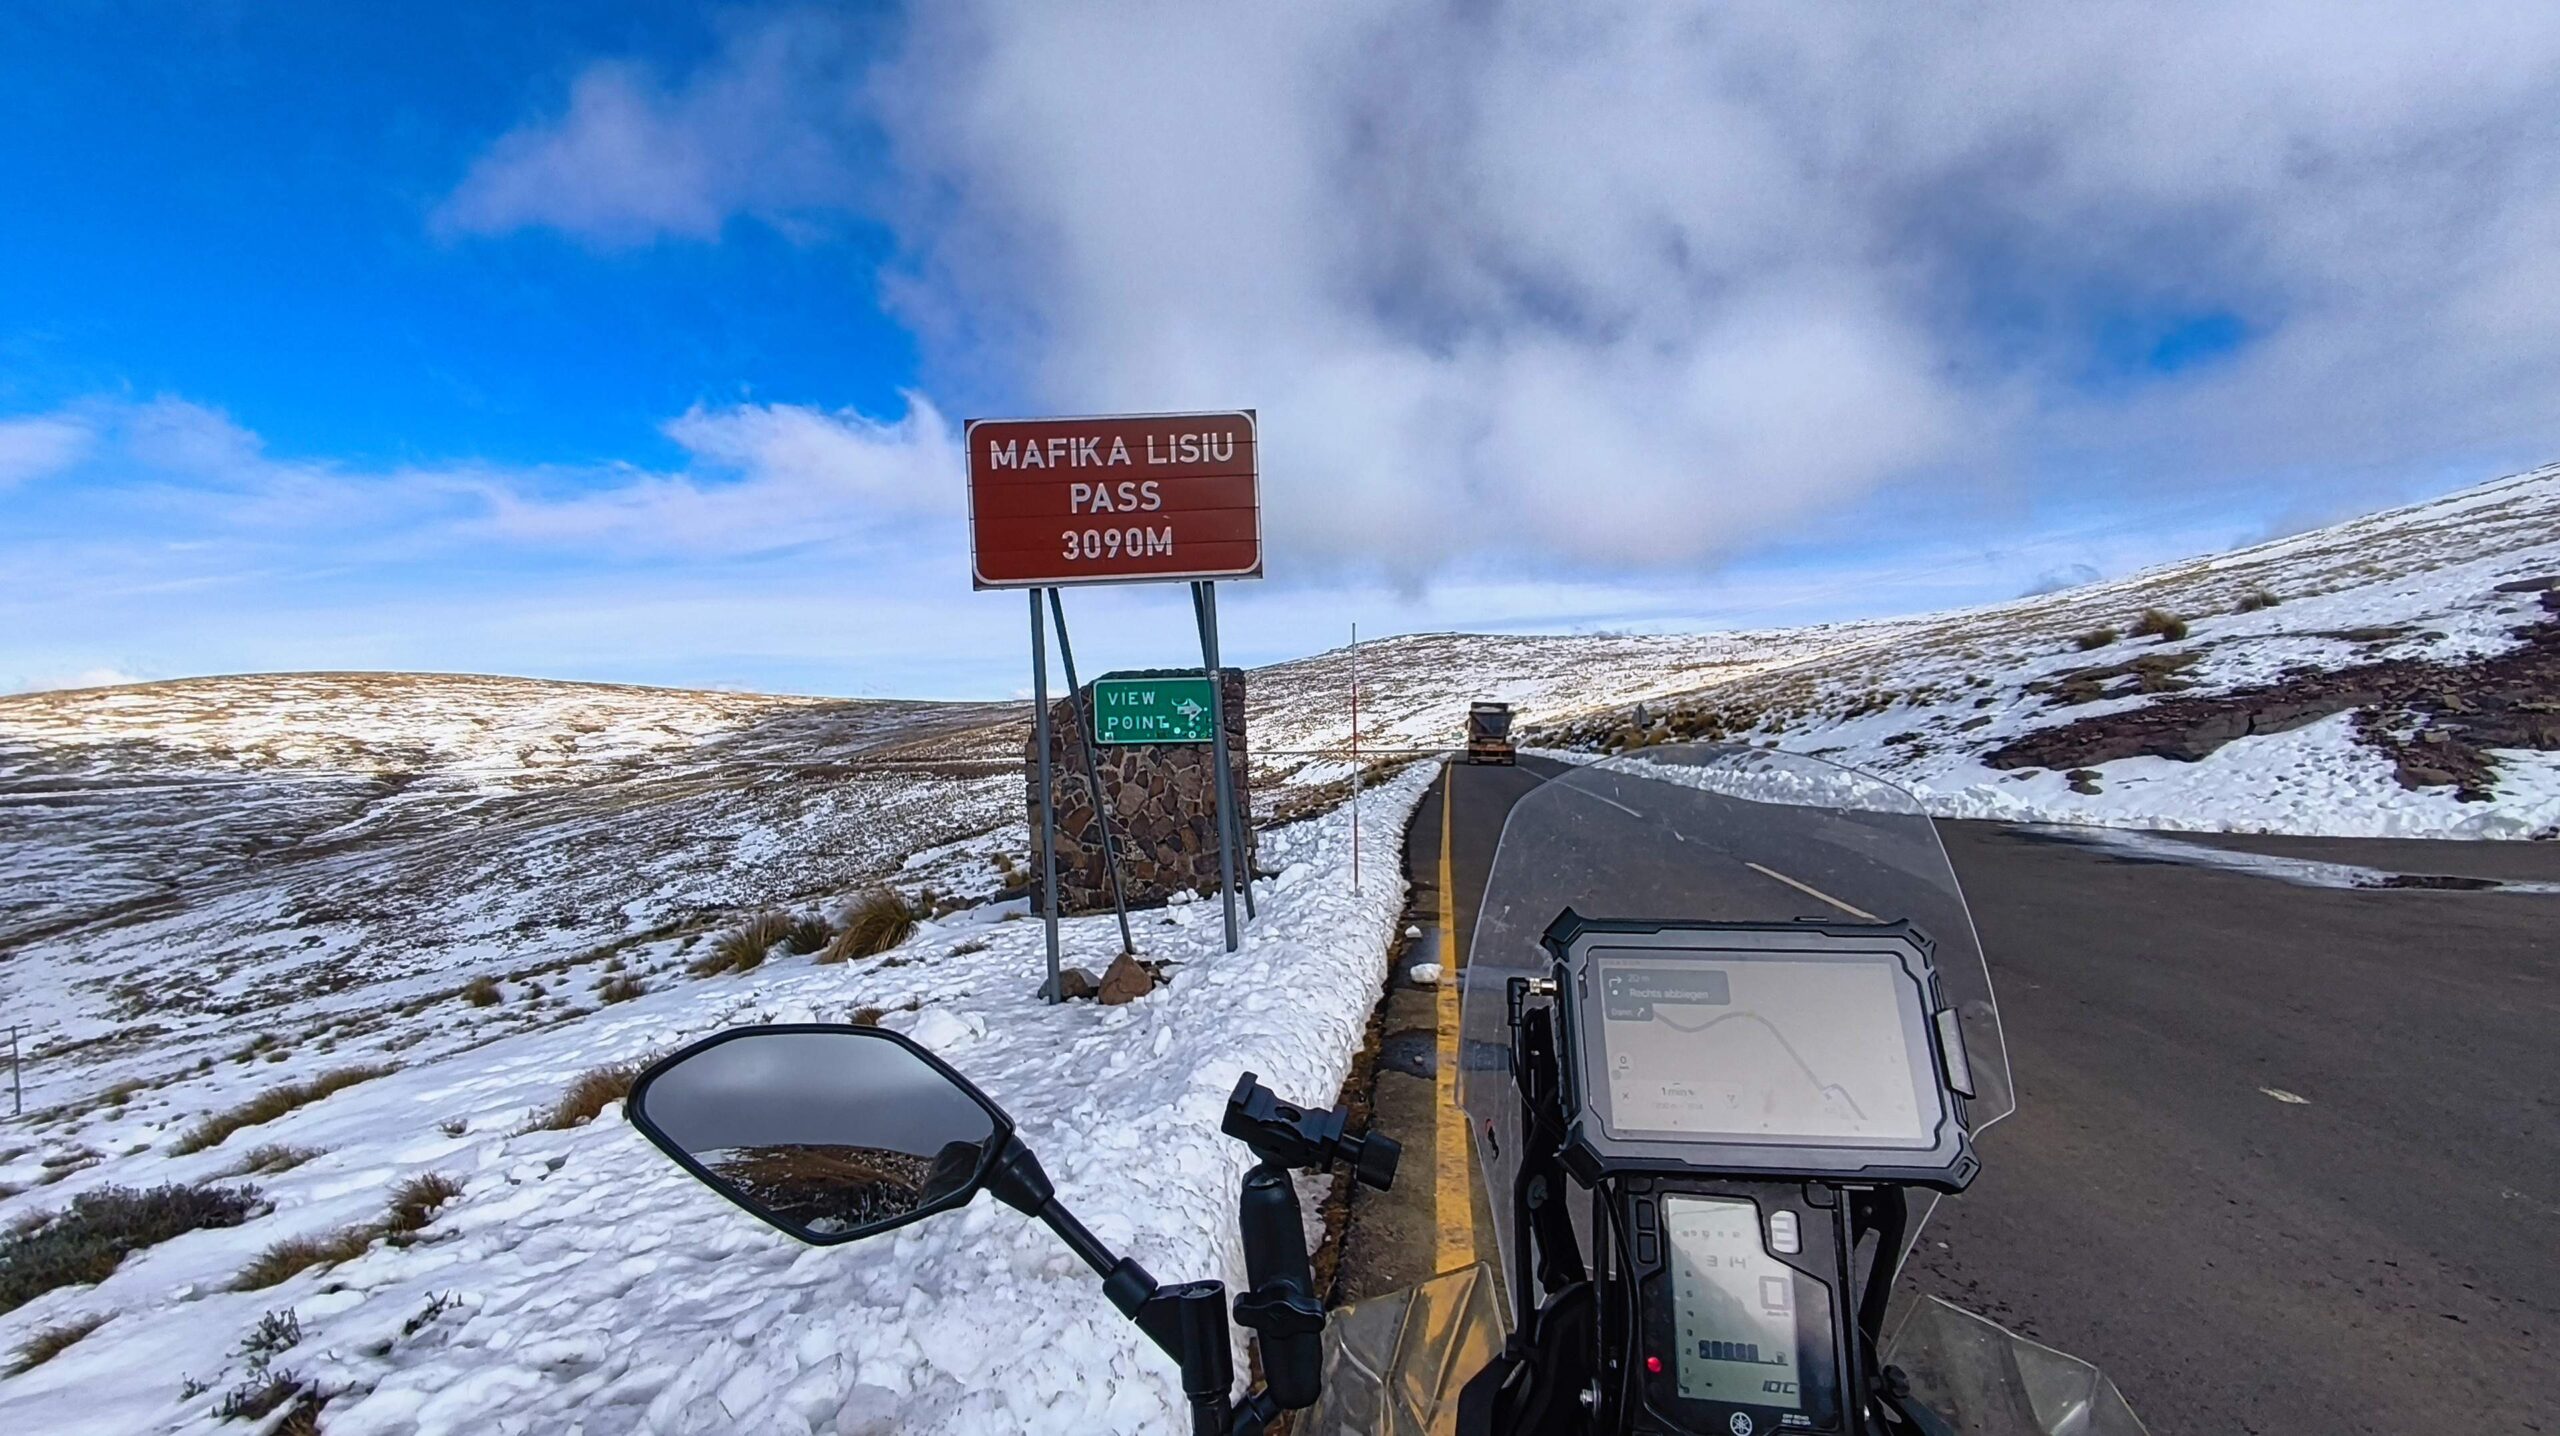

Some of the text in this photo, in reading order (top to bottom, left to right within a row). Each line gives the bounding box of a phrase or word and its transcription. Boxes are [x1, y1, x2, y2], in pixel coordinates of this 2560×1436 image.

[990, 432, 1234, 470] MAFIKA LISIU
[1070, 481, 1162, 514] PASS
[1061, 526, 1173, 560] 3090M
[1107, 692, 1155, 705] VIEW
[1108, 715, 1166, 730] POINT
[1629, 988, 1709, 1001] Rechts abbiegen
